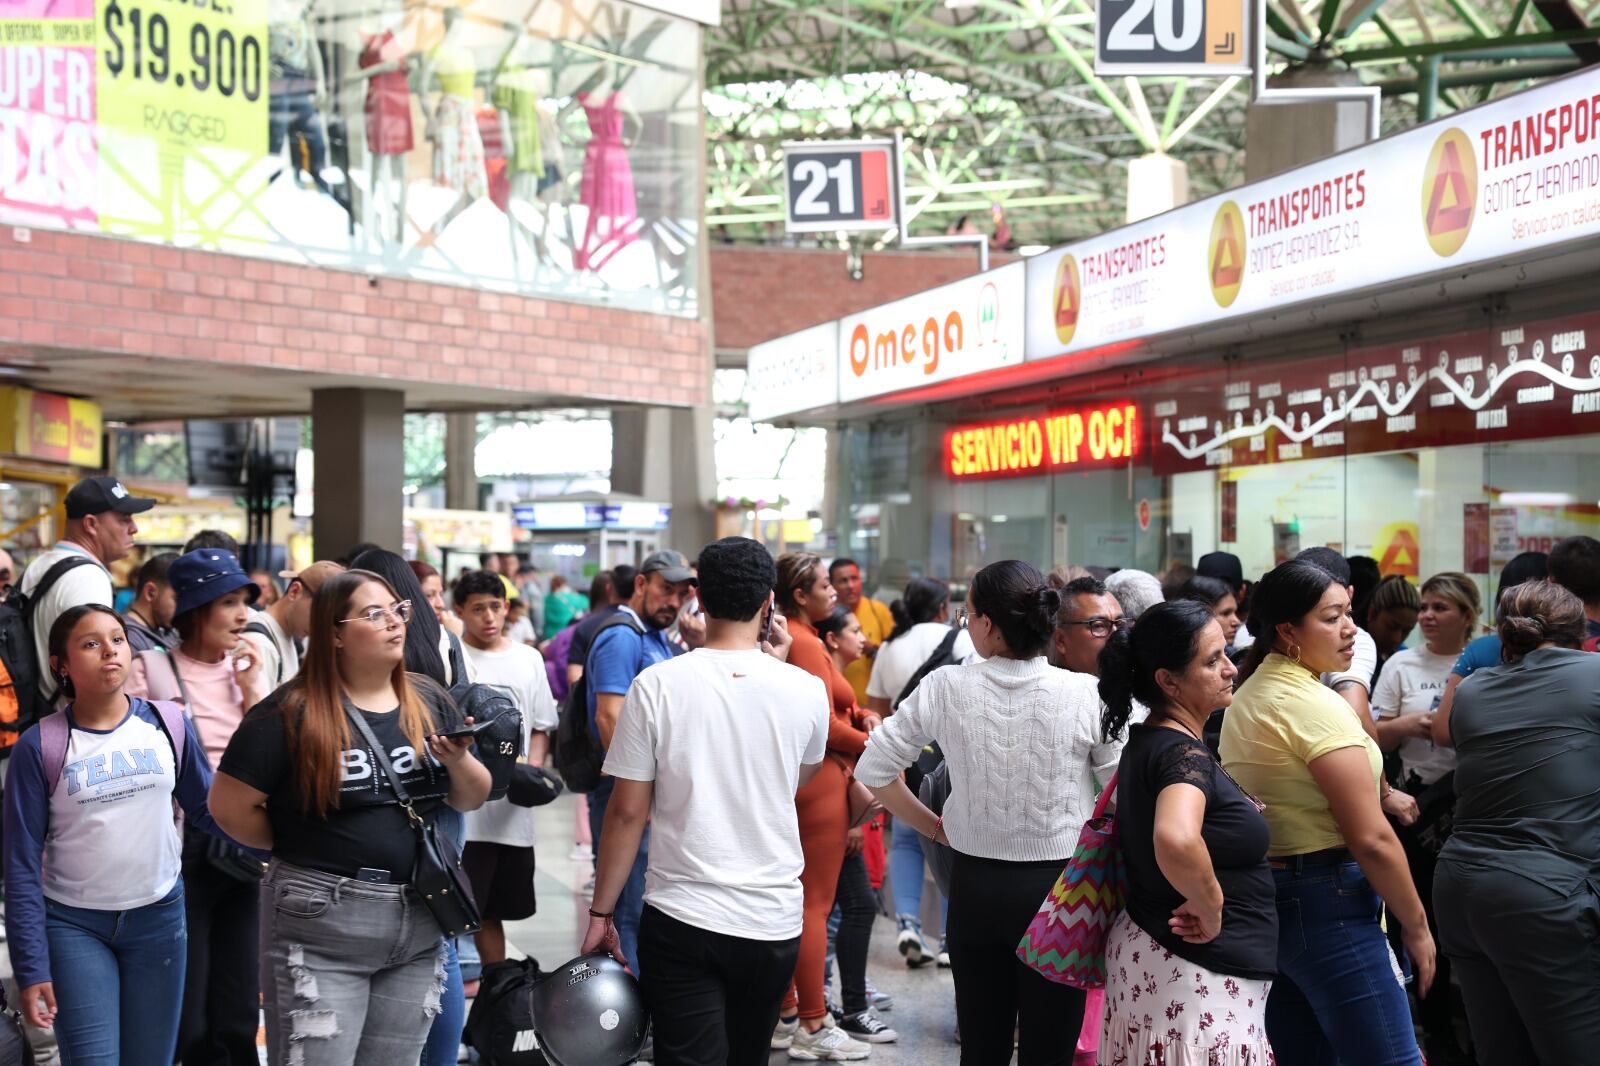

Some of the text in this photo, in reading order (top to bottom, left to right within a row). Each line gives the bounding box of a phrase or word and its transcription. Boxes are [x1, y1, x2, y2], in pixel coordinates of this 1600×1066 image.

[103, 0, 261, 102] $19.900
[1106, 0, 1203, 52] 20
[143, 104, 227, 142] RAGGED
[1480, 94, 1600, 171] TRANSPOR
[793, 158, 855, 215] 21
[1248, 169, 1366, 238] TRANSPORTES
[1484, 172, 1532, 214] GOMEZ
[1511, 216, 1548, 240] Servicio
[1551, 211, 1570, 231] con
[1081, 233, 1166, 287] TRANSPORTES
[850, 310, 964, 377] Omega
[951, 419, 1043, 476] SERVICIO
[1045, 413, 1084, 465] VIP
[63, 748, 165, 797] TEAM
